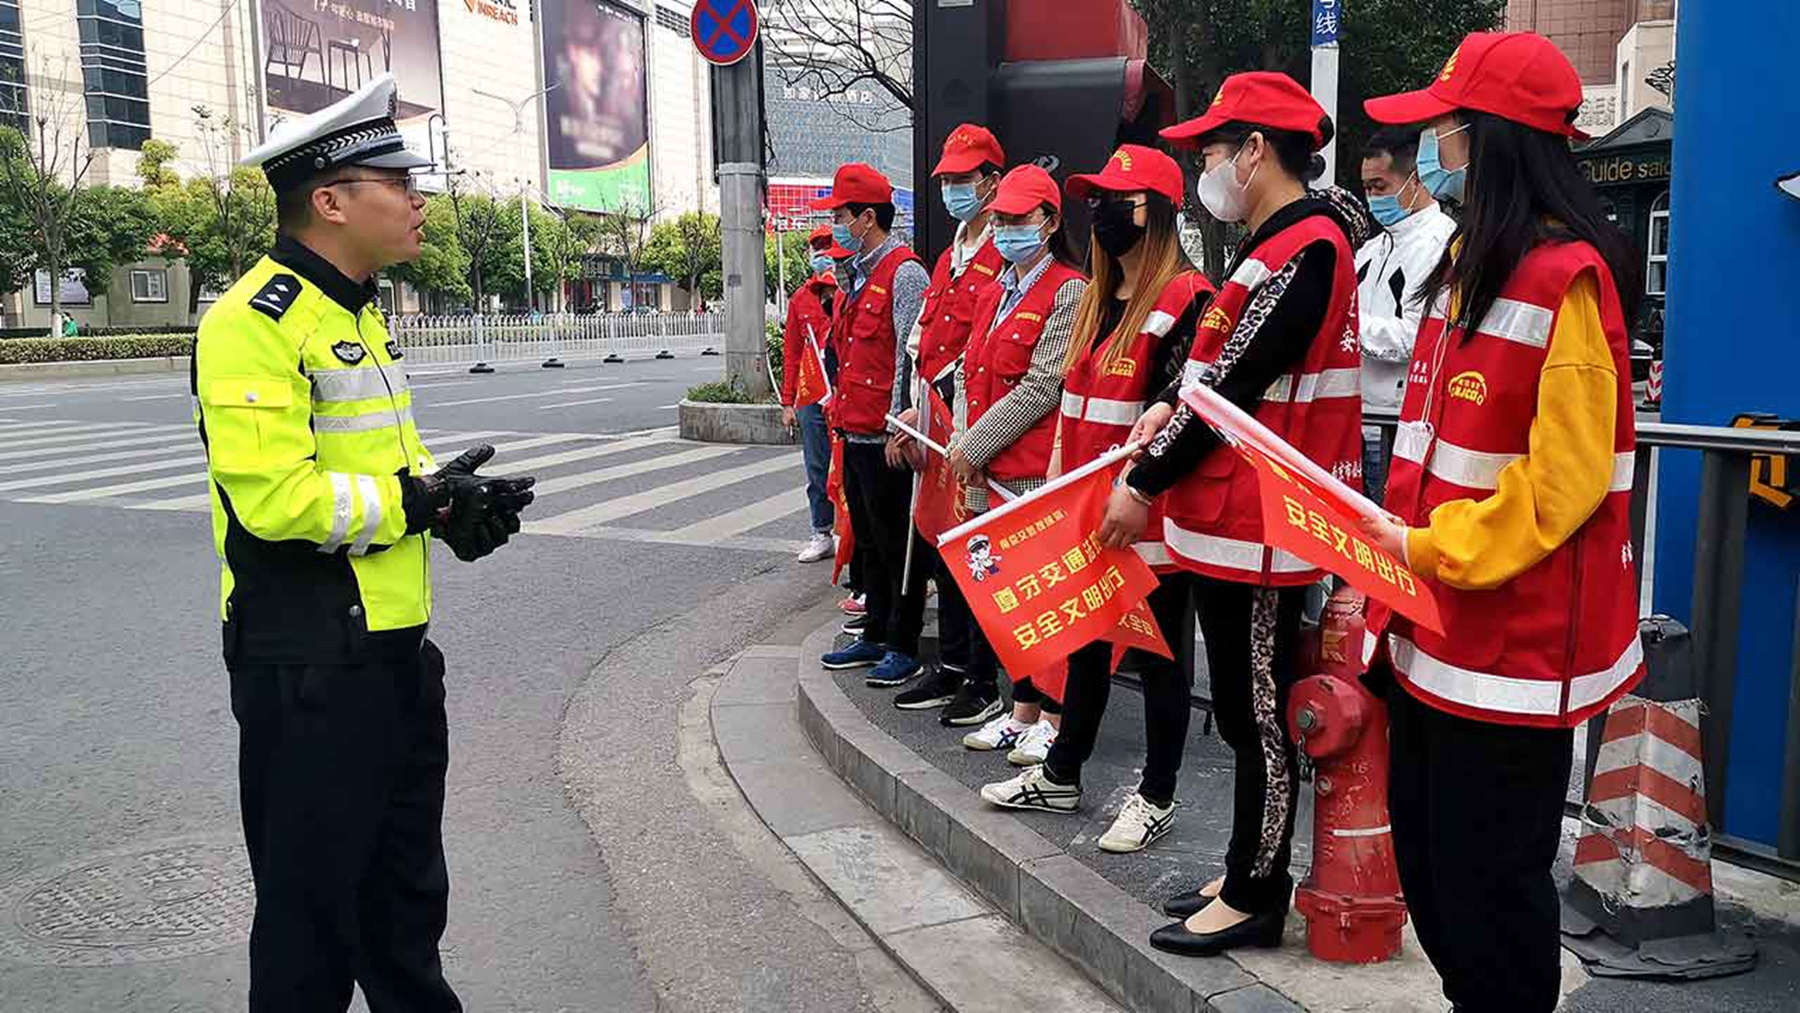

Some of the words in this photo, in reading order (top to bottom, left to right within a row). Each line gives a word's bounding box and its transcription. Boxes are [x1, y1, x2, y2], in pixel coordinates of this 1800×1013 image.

[1283, 495, 1417, 597] 安全文明出行
[1012, 564, 1126, 650] 安全文明出行
